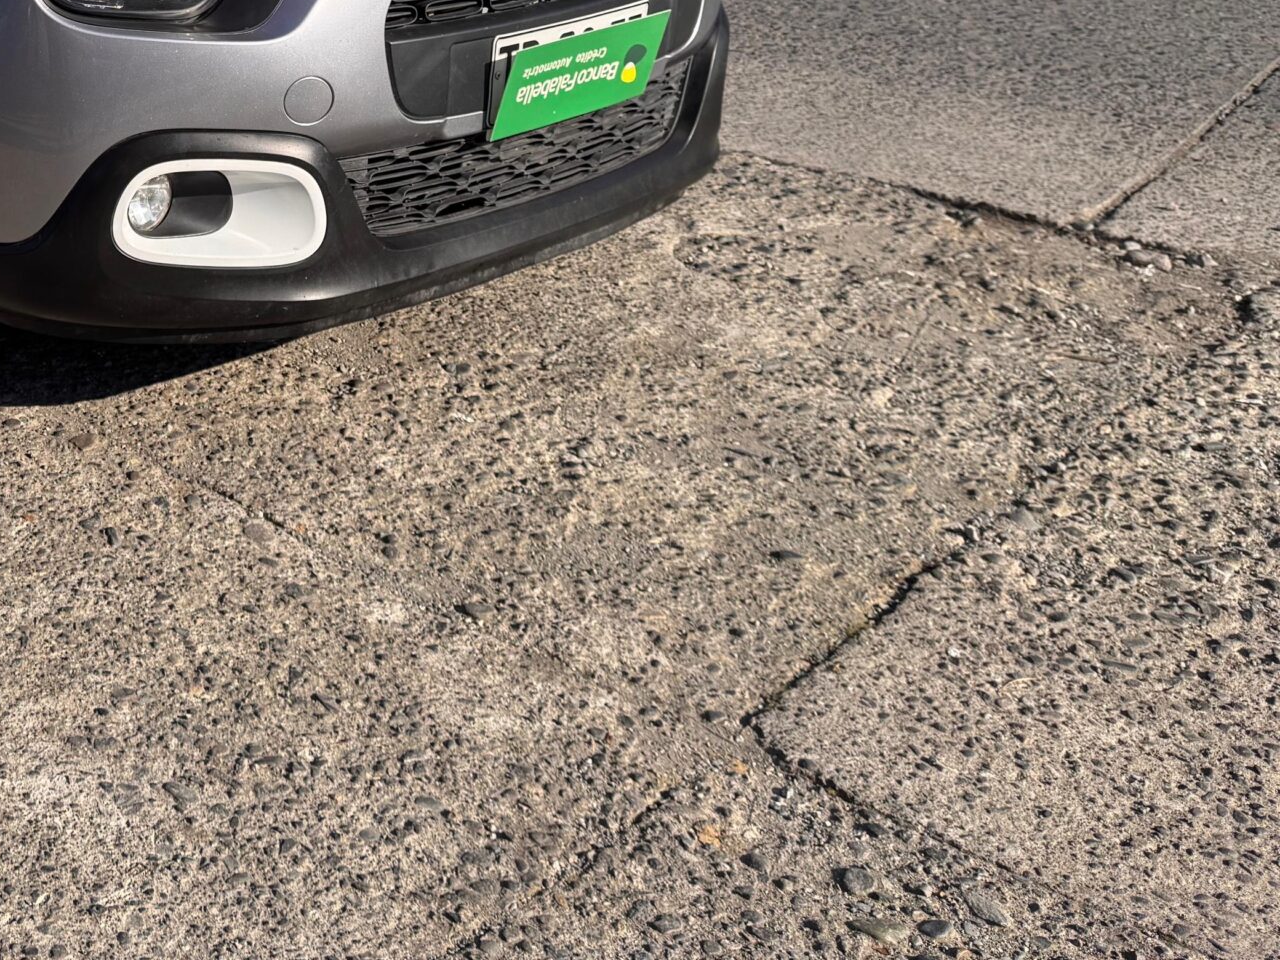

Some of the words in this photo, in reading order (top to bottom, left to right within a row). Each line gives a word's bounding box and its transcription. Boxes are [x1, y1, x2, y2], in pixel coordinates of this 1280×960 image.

[575, 46, 608, 62] Crédito
[523, 55, 572, 80] Automotriz
[516, 61, 619, 104] BancoFalabella
